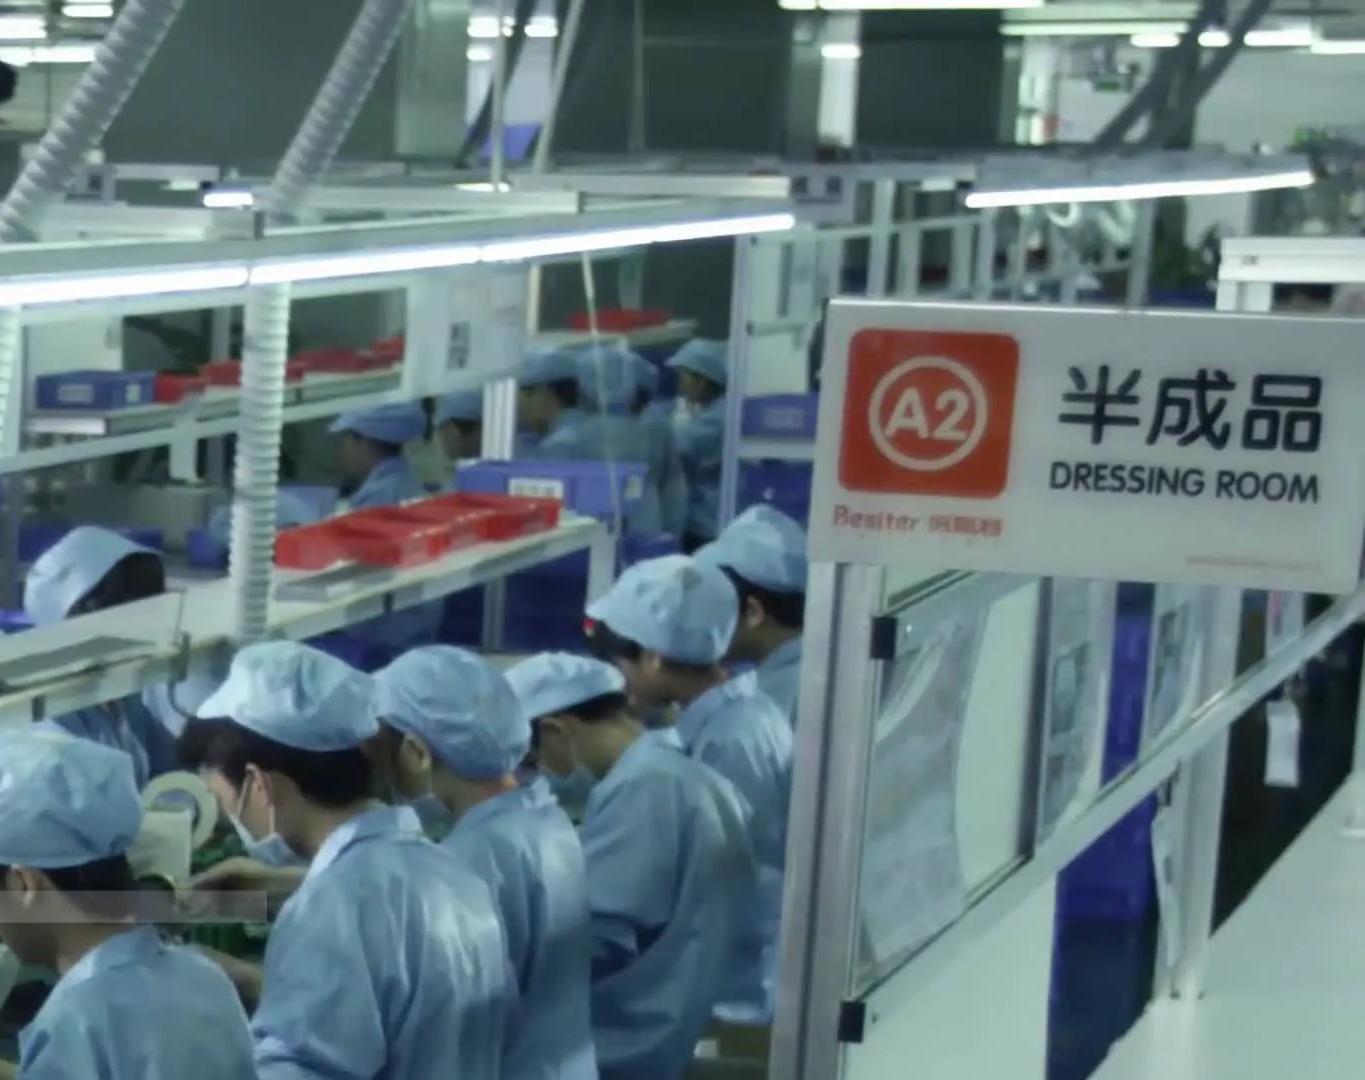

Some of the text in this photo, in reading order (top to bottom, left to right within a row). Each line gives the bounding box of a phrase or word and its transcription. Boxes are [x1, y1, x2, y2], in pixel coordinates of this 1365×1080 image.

[884, 386, 970, 442] A2
[1057, 364, 1324, 453] 半成品
[1049, 461, 1320, 503] DRESSING ROOM
